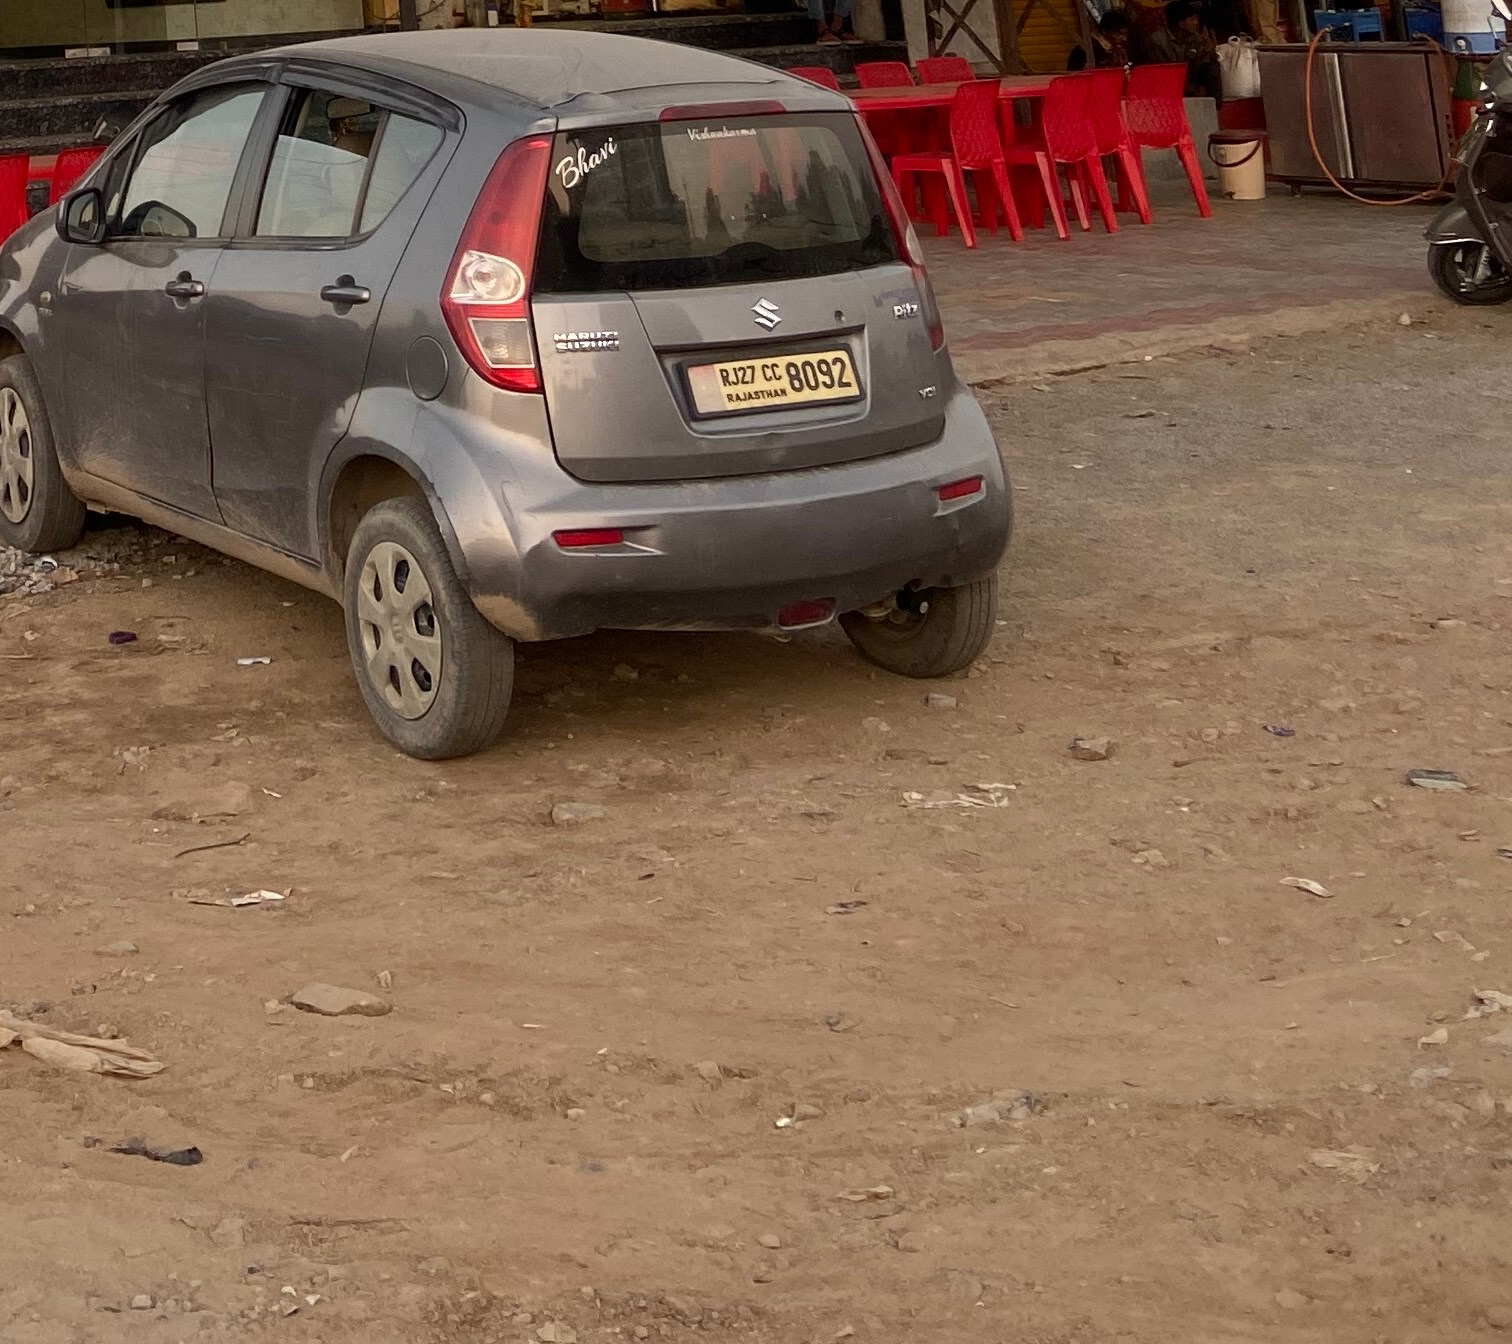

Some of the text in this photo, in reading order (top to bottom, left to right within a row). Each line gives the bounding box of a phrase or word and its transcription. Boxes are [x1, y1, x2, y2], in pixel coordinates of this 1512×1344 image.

[555, 136, 618, 189] Bhavi
[553, 330, 619, 342] MARUTI
[555, 340, 620, 353] SUZUKI
[718, 356, 852, 393] RJ27 CC 8092
[726, 387, 787, 403] RAJASTHAN
